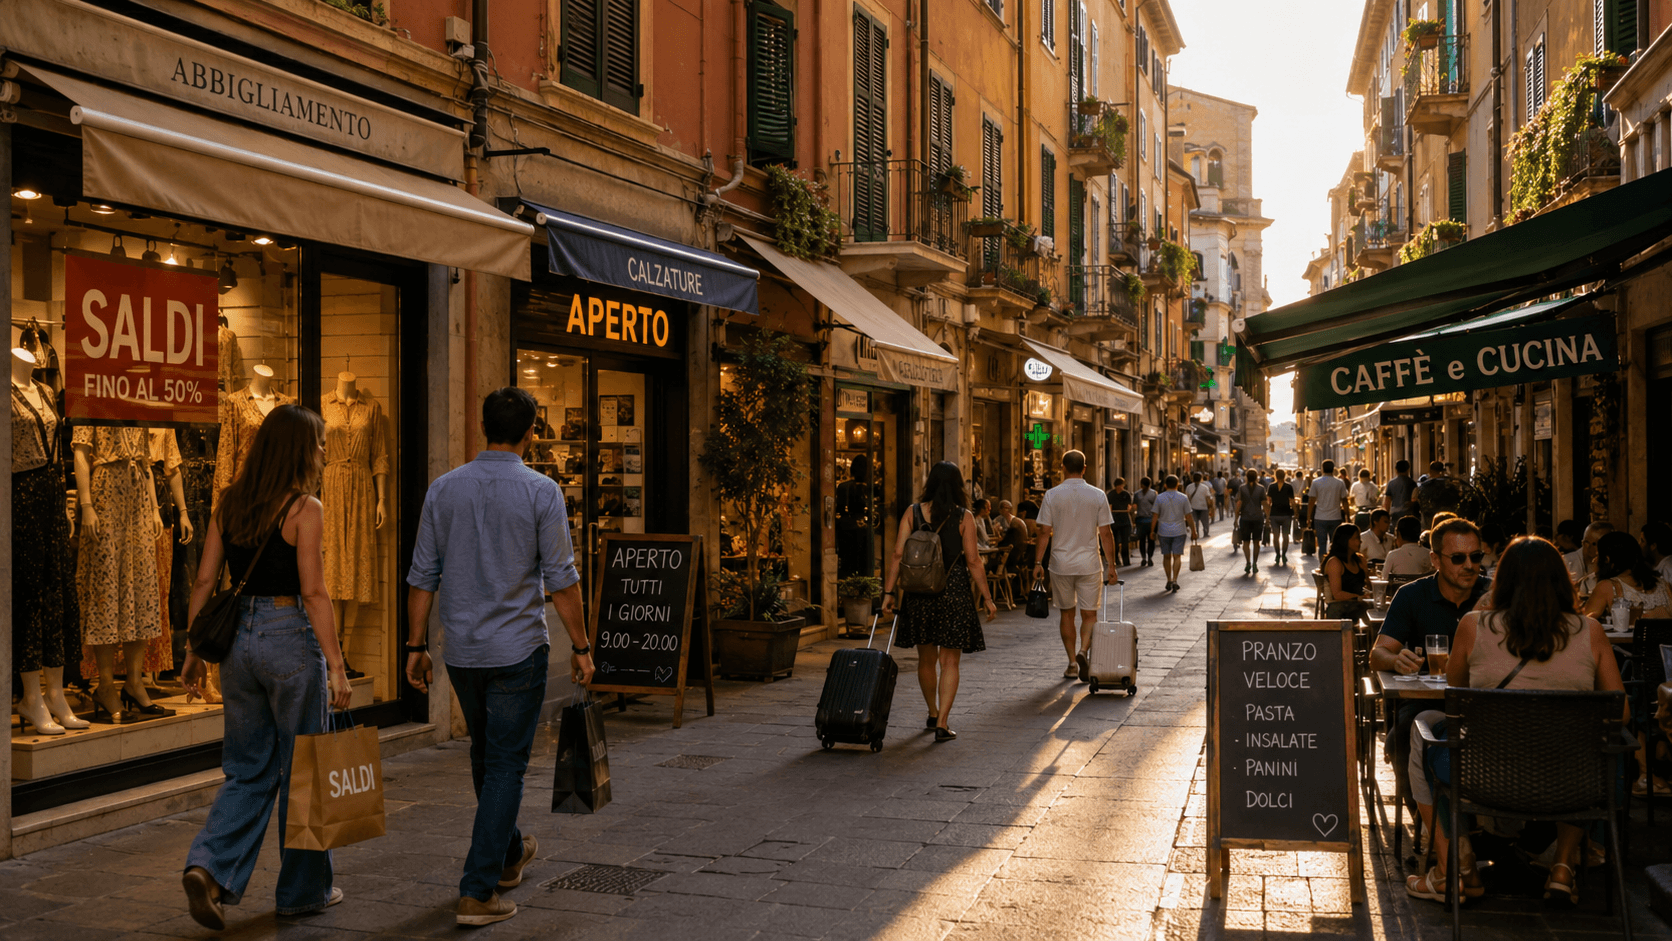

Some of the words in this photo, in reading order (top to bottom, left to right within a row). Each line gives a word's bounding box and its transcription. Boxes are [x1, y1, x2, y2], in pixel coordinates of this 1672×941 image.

[170, 57, 371, 140] ABBIGLIAMENTO
[627, 256, 703, 296] CALZATURE
[80, 288, 204, 367] SALDI
[566, 293, 669, 348] APERTO
[1330, 349, 1434, 396] CAFFÈ
[1447, 360, 1465, 380] e
[1476, 333, 1604, 377] CUCINA
[84, 373, 130, 400] FINO
[135, 377, 159, 401] AL
[164, 378, 203, 404] 50%
[611, 547, 682, 570] APERTO
[620, 578, 663, 595] TUTTI
[608, 603, 613, 621] I
[618, 603, 671, 622] GIORNI
[1242, 640, 1317, 661] PRANZO
[1243, 671, 1311, 689] VELOCE
[1245, 703, 1295, 721] PASTA
[1246, 732, 1318, 749] INSALATE
[328, 763, 375, 799] SALDI
